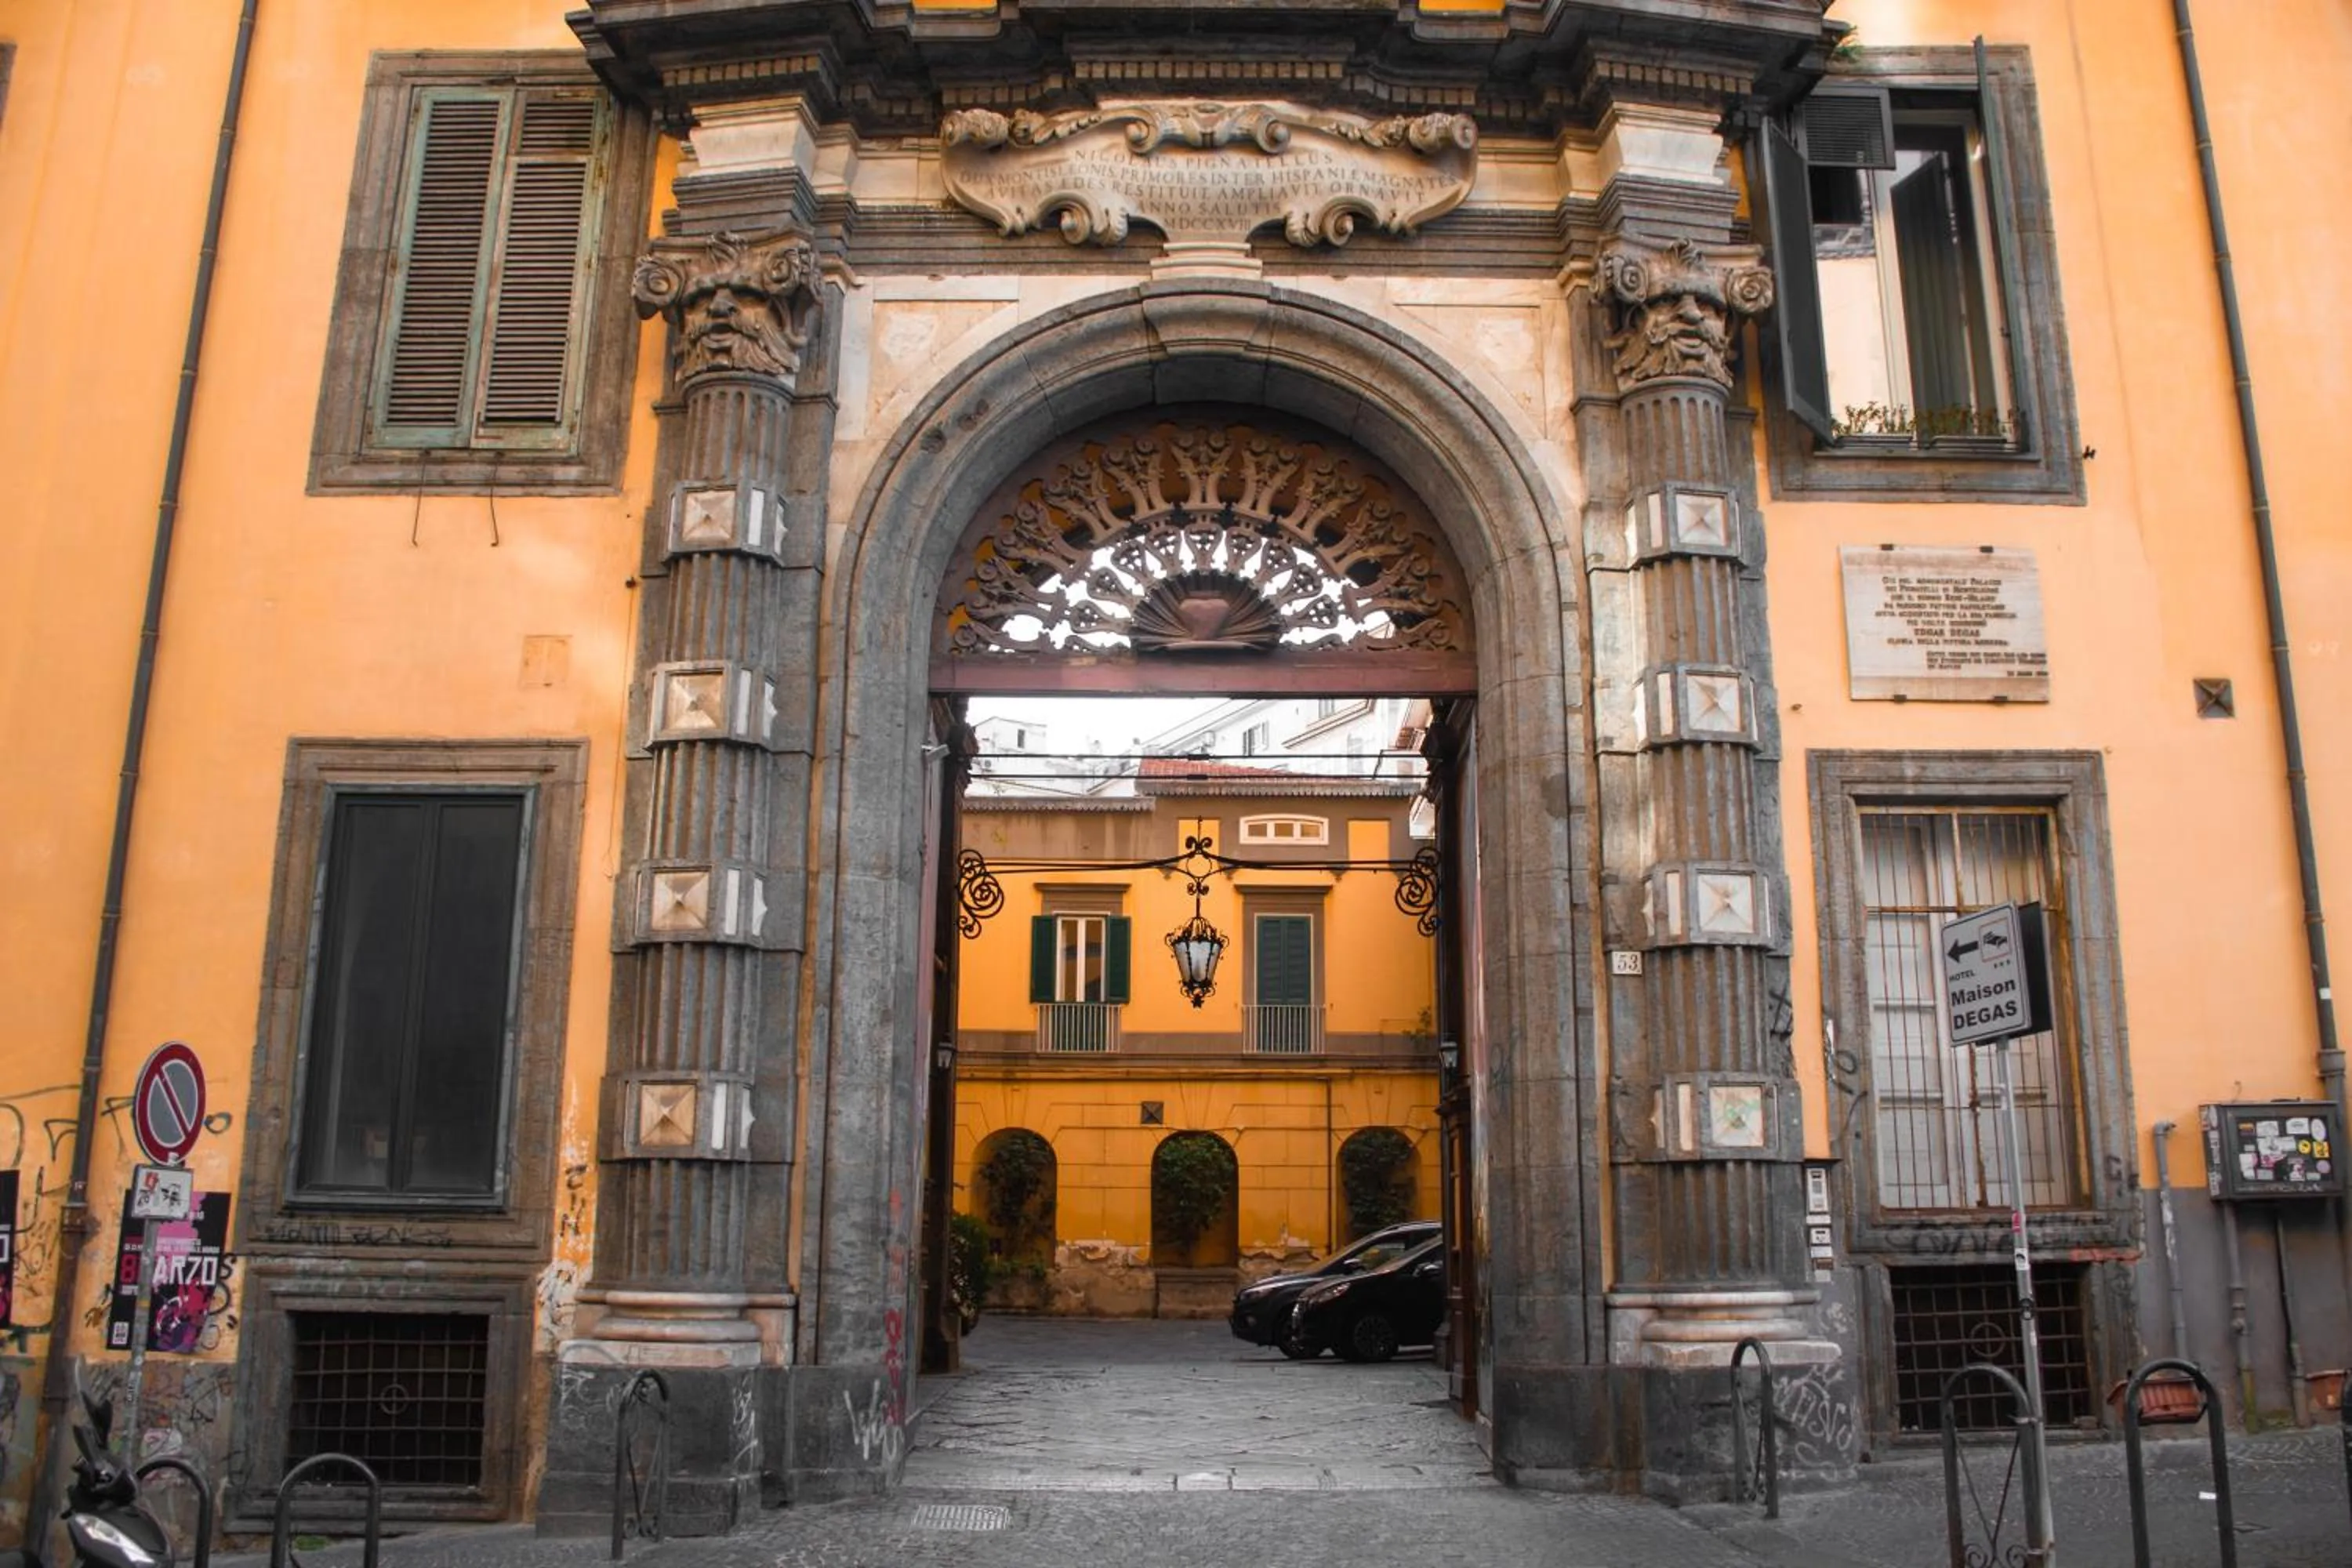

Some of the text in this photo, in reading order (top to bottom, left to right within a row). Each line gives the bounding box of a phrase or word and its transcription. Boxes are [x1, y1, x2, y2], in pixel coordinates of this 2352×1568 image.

[1186, 153, 1333, 169] PIGNATELLUS
[1121, 168, 1209, 185] PRIMORES
[1213, 170, 1265, 186] INTER
[1218, 183, 1320, 200] AMPLIAVIT
[1330, 181, 1428, 204] ORNAVIT
[1138, 201, 1281, 216] ANNO SALUTIS
[1617, 953, 1639, 971] 53
[1949, 969, 1976, 982] HOTEL
[1950, 978, 2016, 1007] Maison
[1953, 1000, 2018, 1030] DEGAS
[152, 1254, 218, 1286] ARZO
